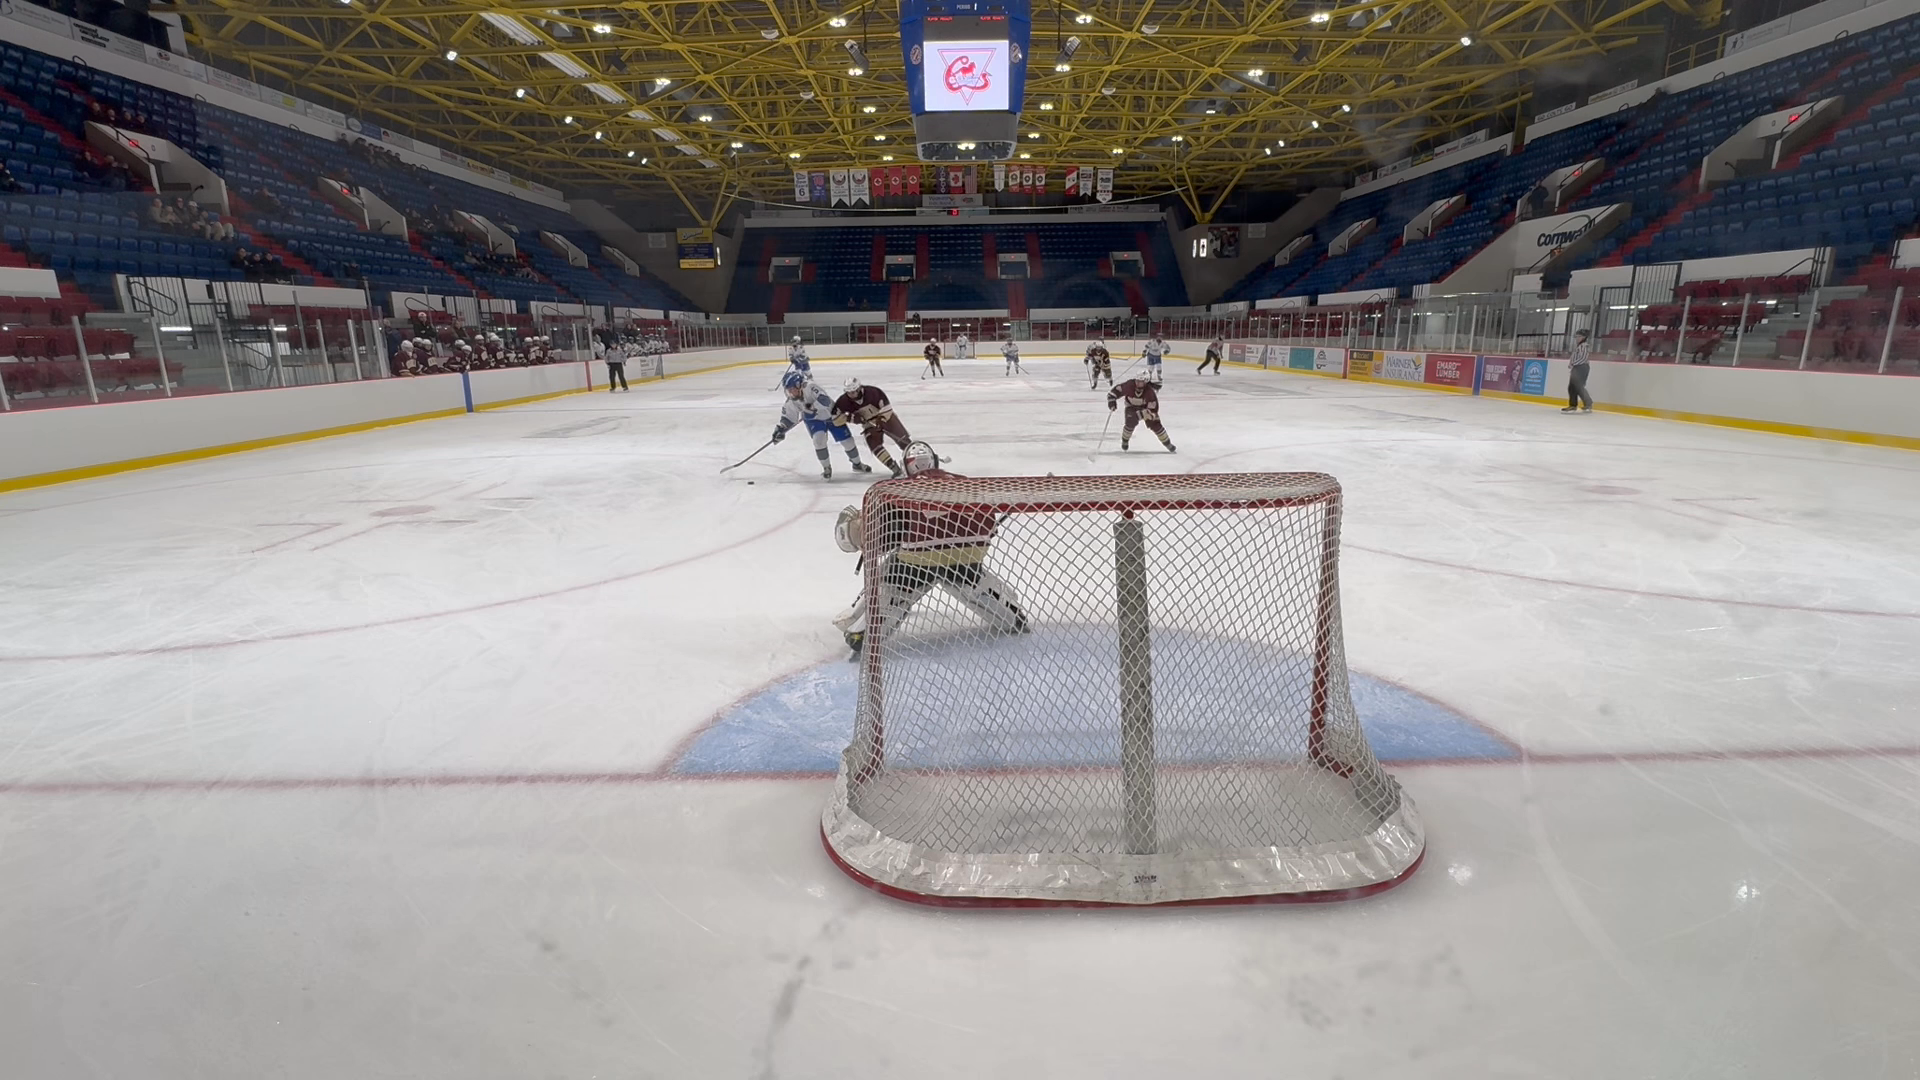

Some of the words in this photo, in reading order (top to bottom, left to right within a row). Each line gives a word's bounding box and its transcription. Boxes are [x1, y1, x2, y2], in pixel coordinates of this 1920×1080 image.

[1546, 108, 1562, 119] COLTS
[1564, 104, 1573, 112] GO
[798, 187, 806, 197] 6
[1386, 355, 1412, 370] WARNER
[1436, 360, 1457, 370] EMARD
[1435, 369, 1460, 379] LUMBER
[1494, 364, 1508, 374] ESCAPE
[1384, 367, 1422, 382] INSURANCE
